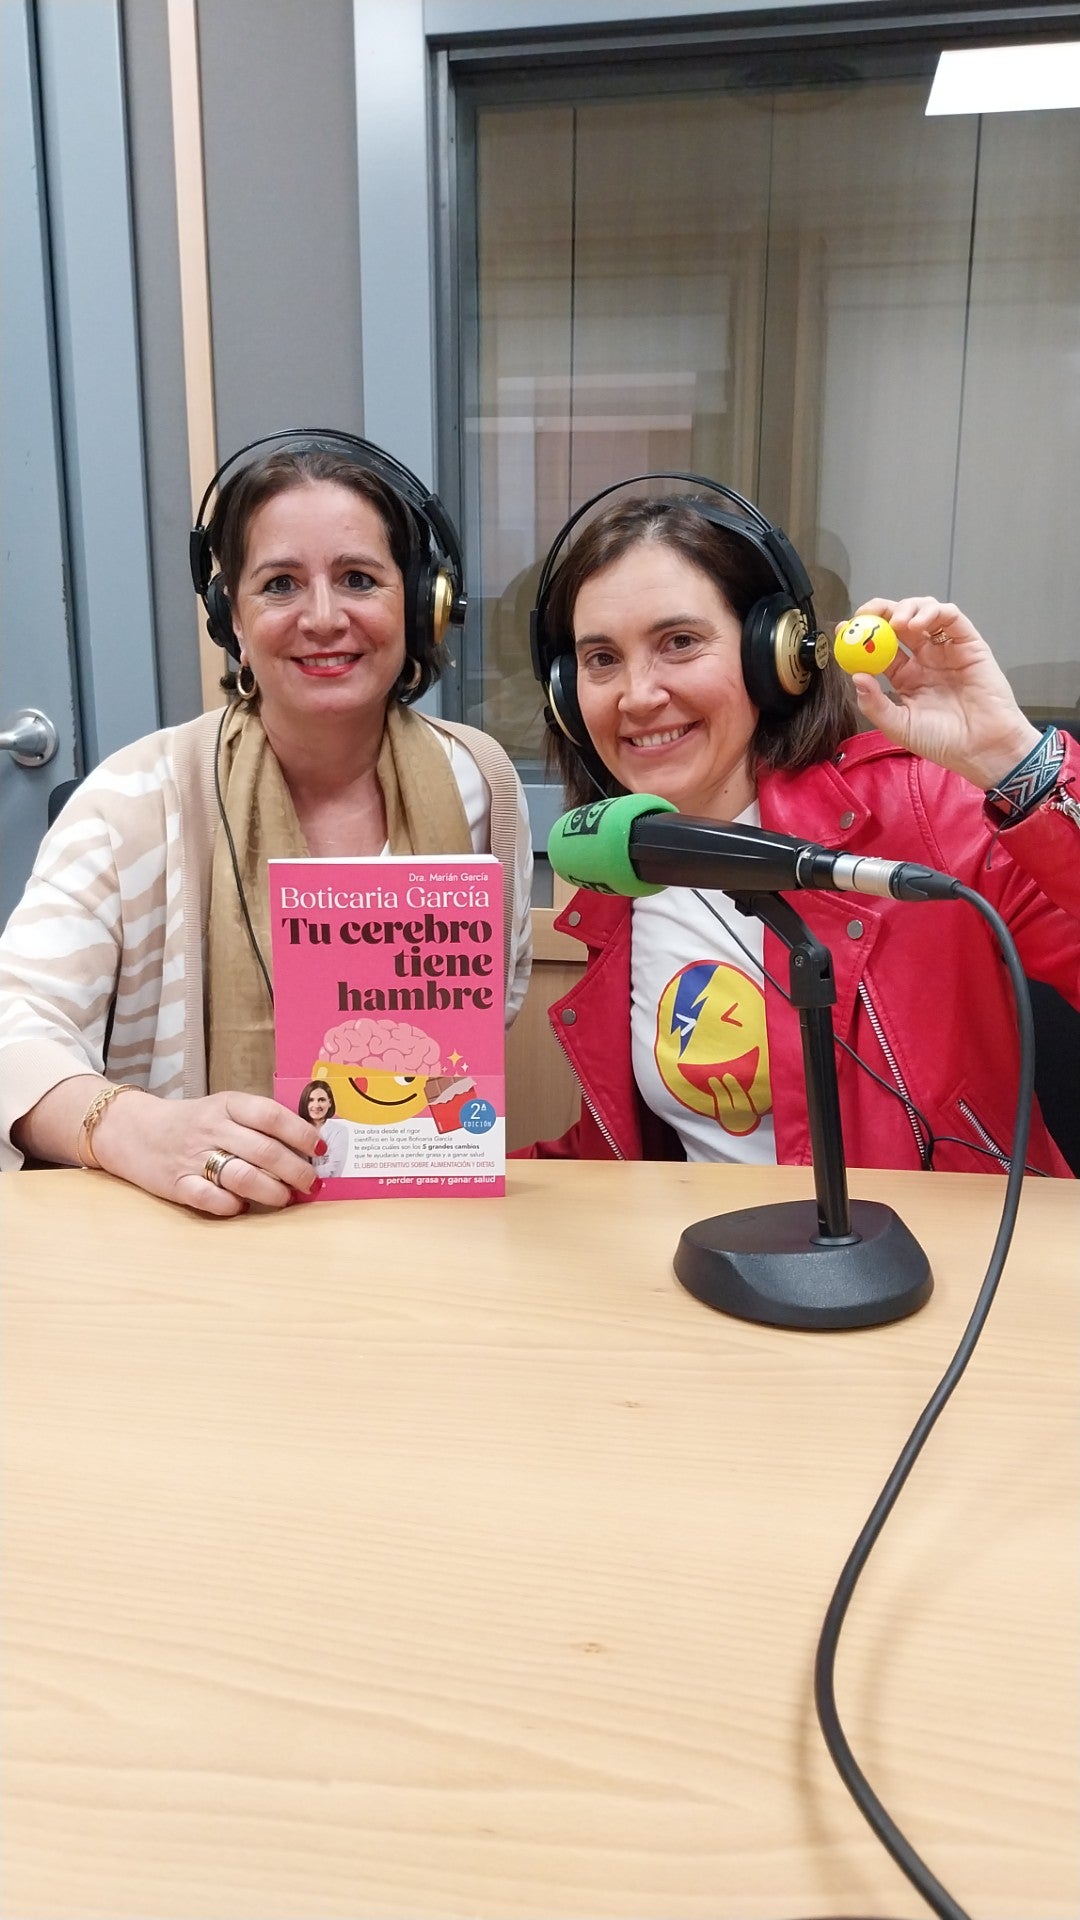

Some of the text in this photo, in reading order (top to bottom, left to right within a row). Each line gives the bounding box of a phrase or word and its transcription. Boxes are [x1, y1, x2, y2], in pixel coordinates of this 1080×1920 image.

[409, 872, 489, 882] Dra. Marián García
[280, 886, 490, 909] Boticaria García
[282, 914, 492, 945] Tu cerebro
[392, 946, 493, 977] tiene
[337, 981, 493, 1011] hambre
[386, 1177, 414, 1186] perder
[416, 1177, 439, 1186] grasa
[440, 1178, 446, 1186] y
[448, 1176, 472, 1186] ganar
[474, 1175, 496, 1184] salud
